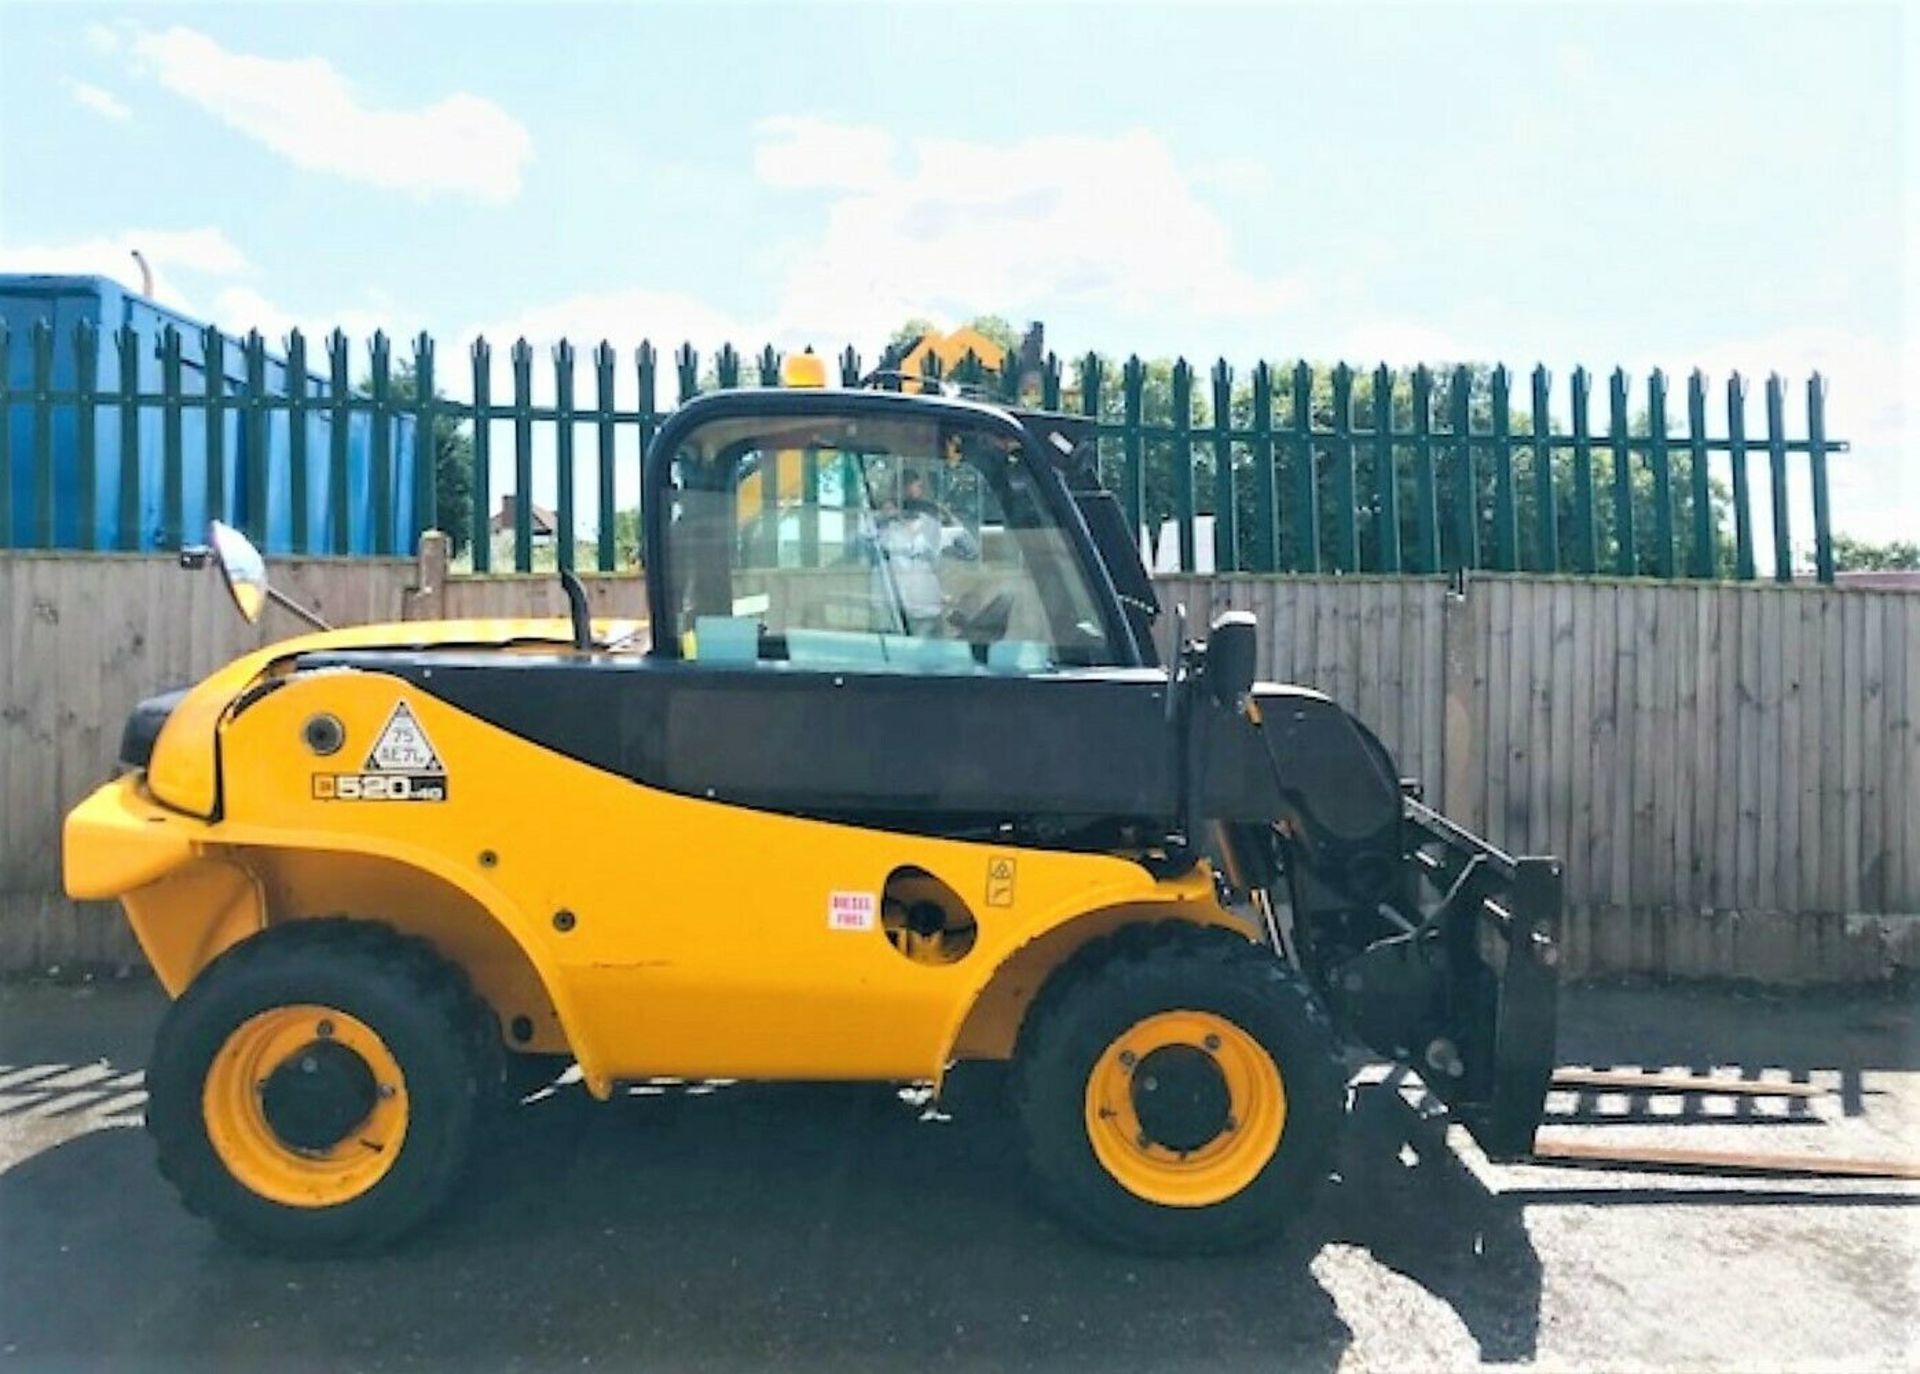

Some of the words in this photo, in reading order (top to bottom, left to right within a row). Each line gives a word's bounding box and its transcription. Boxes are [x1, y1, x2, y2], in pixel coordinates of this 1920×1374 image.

[392, 727, 414, 743] 75
[833, 896, 870, 910] DIESEL
[837, 913, 864, 926] FUEL
